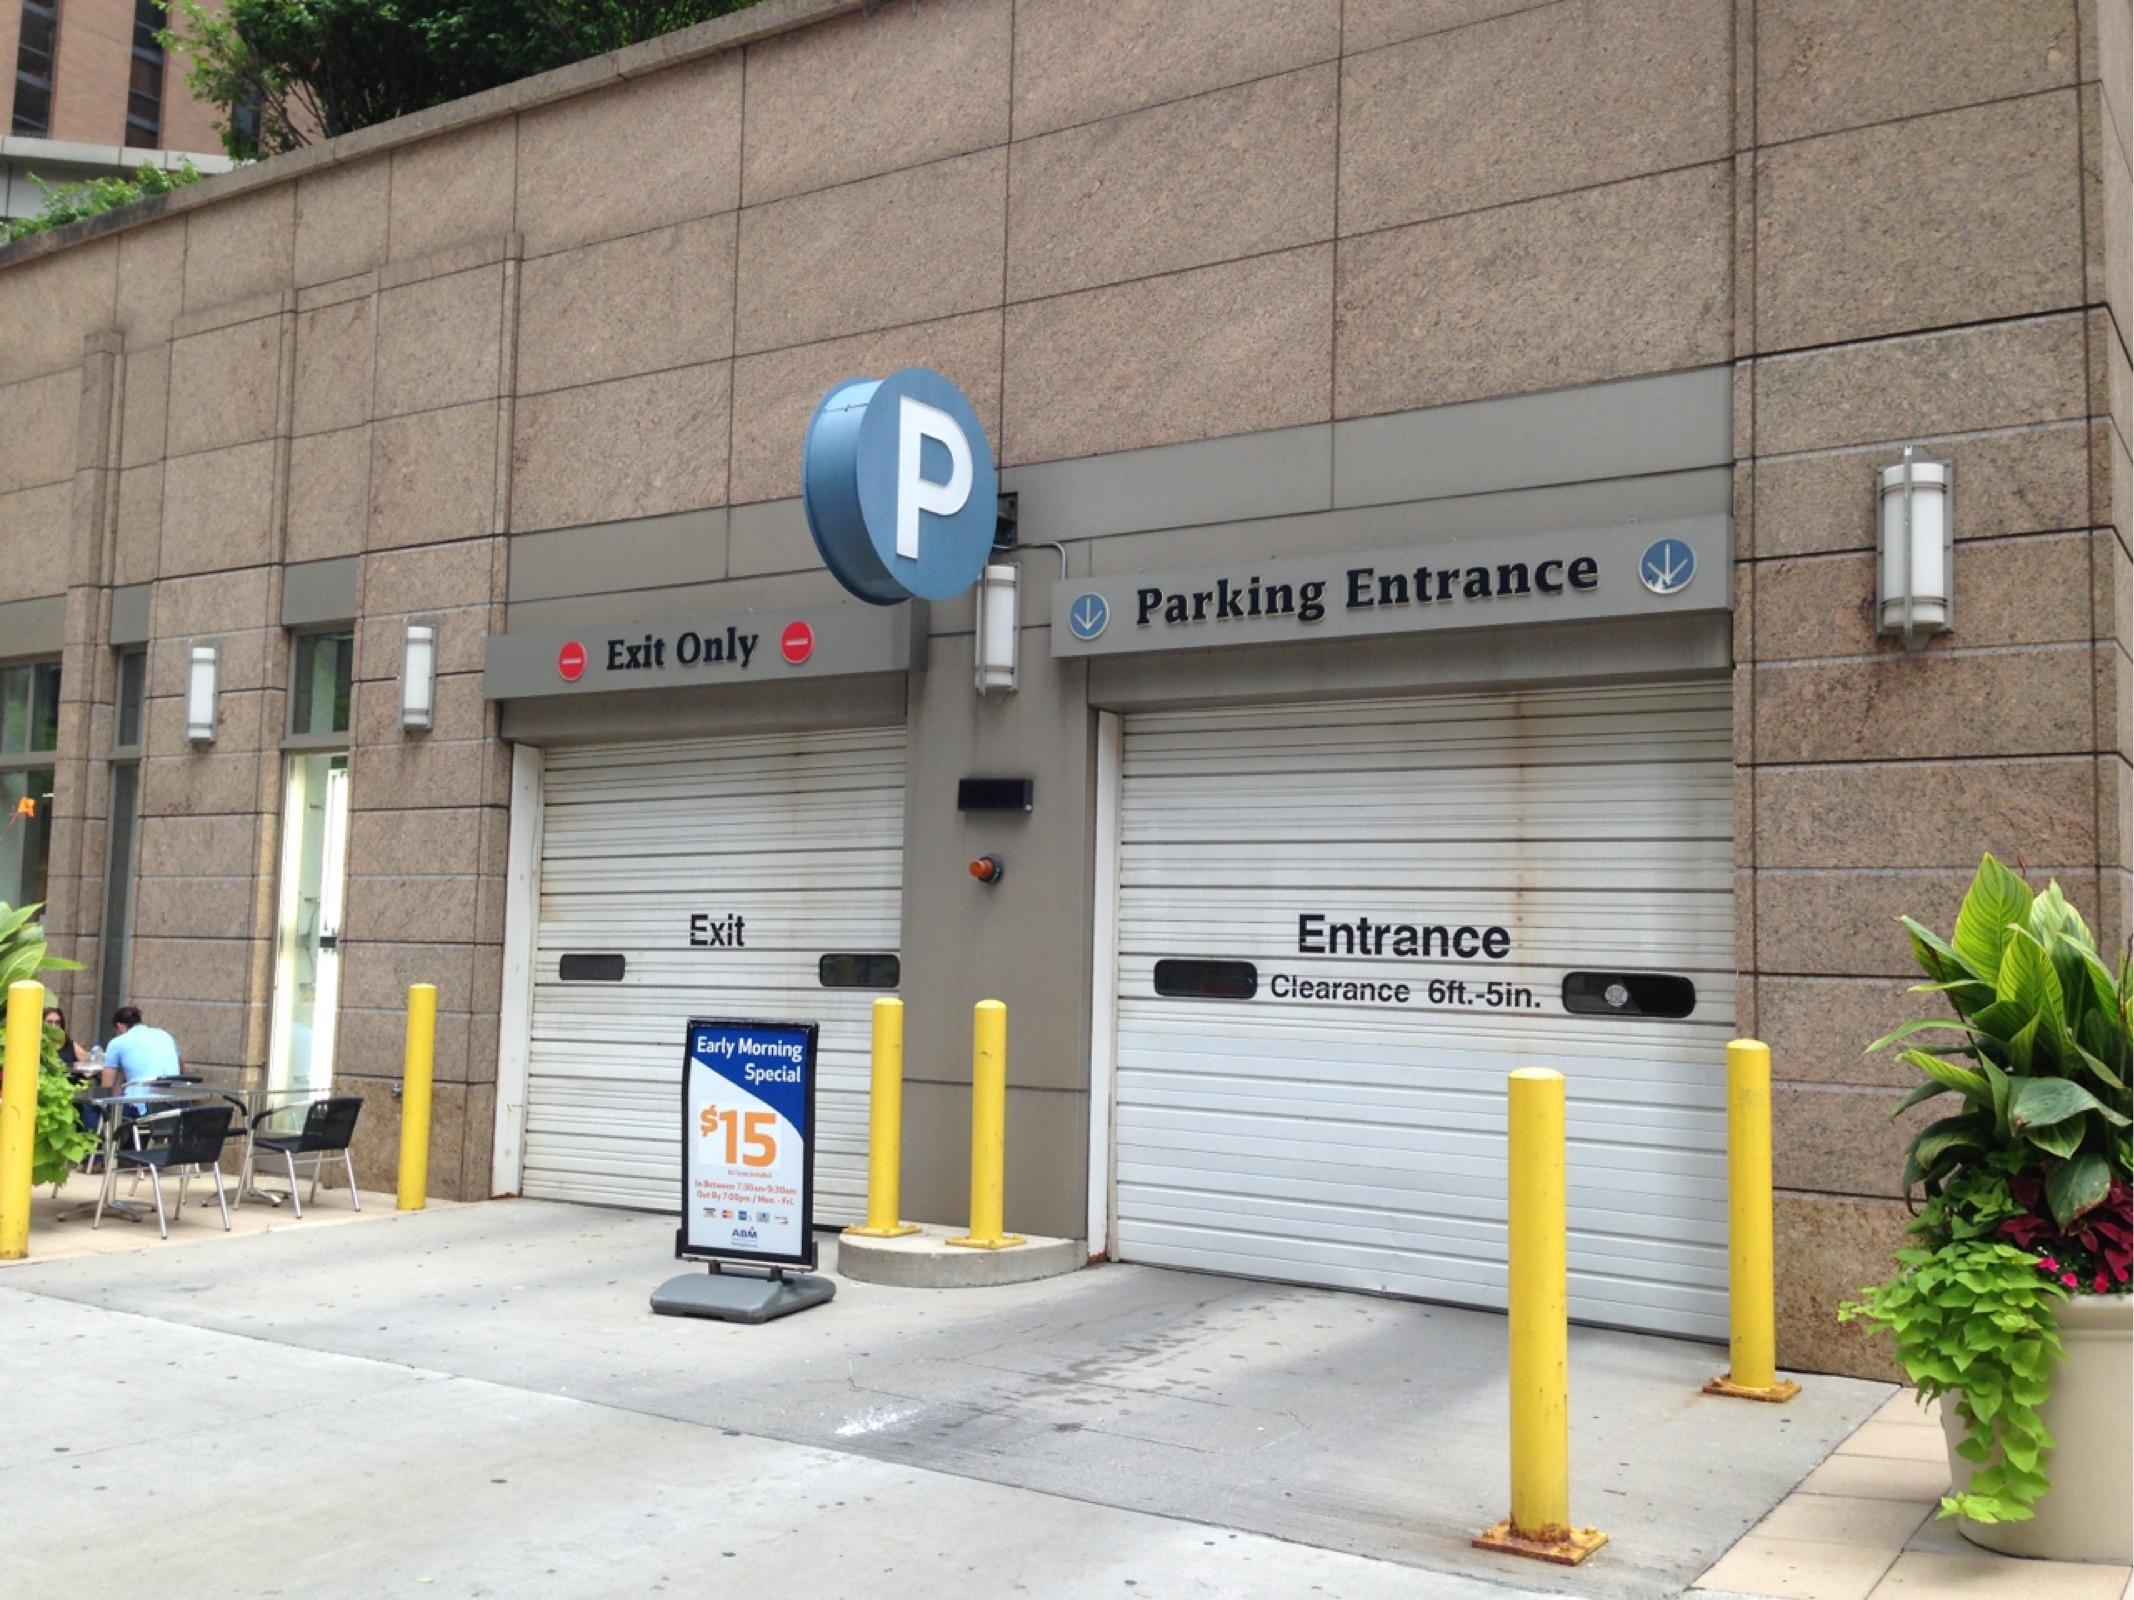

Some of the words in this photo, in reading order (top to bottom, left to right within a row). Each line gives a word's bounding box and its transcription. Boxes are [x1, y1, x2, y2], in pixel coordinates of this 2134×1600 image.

[896, 395, 974, 559] P
[1136, 577, 1327, 625] Parking
[1346, 556, 1599, 608] Entrance
[606, 635, 665, 670] Exit
[676, 627, 759, 667] Only
[690, 913, 745, 947] Exit
[1299, 914, 1511, 958] Entrance
[1271, 974, 1409, 1003] Clearance
[1428, 978, 1541, 1008] 6ft.-5in.
[697, 1036, 735, 1059] Early
[738, 1037, 803, 1062] Morning
[745, 1063, 801, 1085] Special
[700, 1104, 777, 1167] $15
[732, 1229, 758, 1239] ABM
